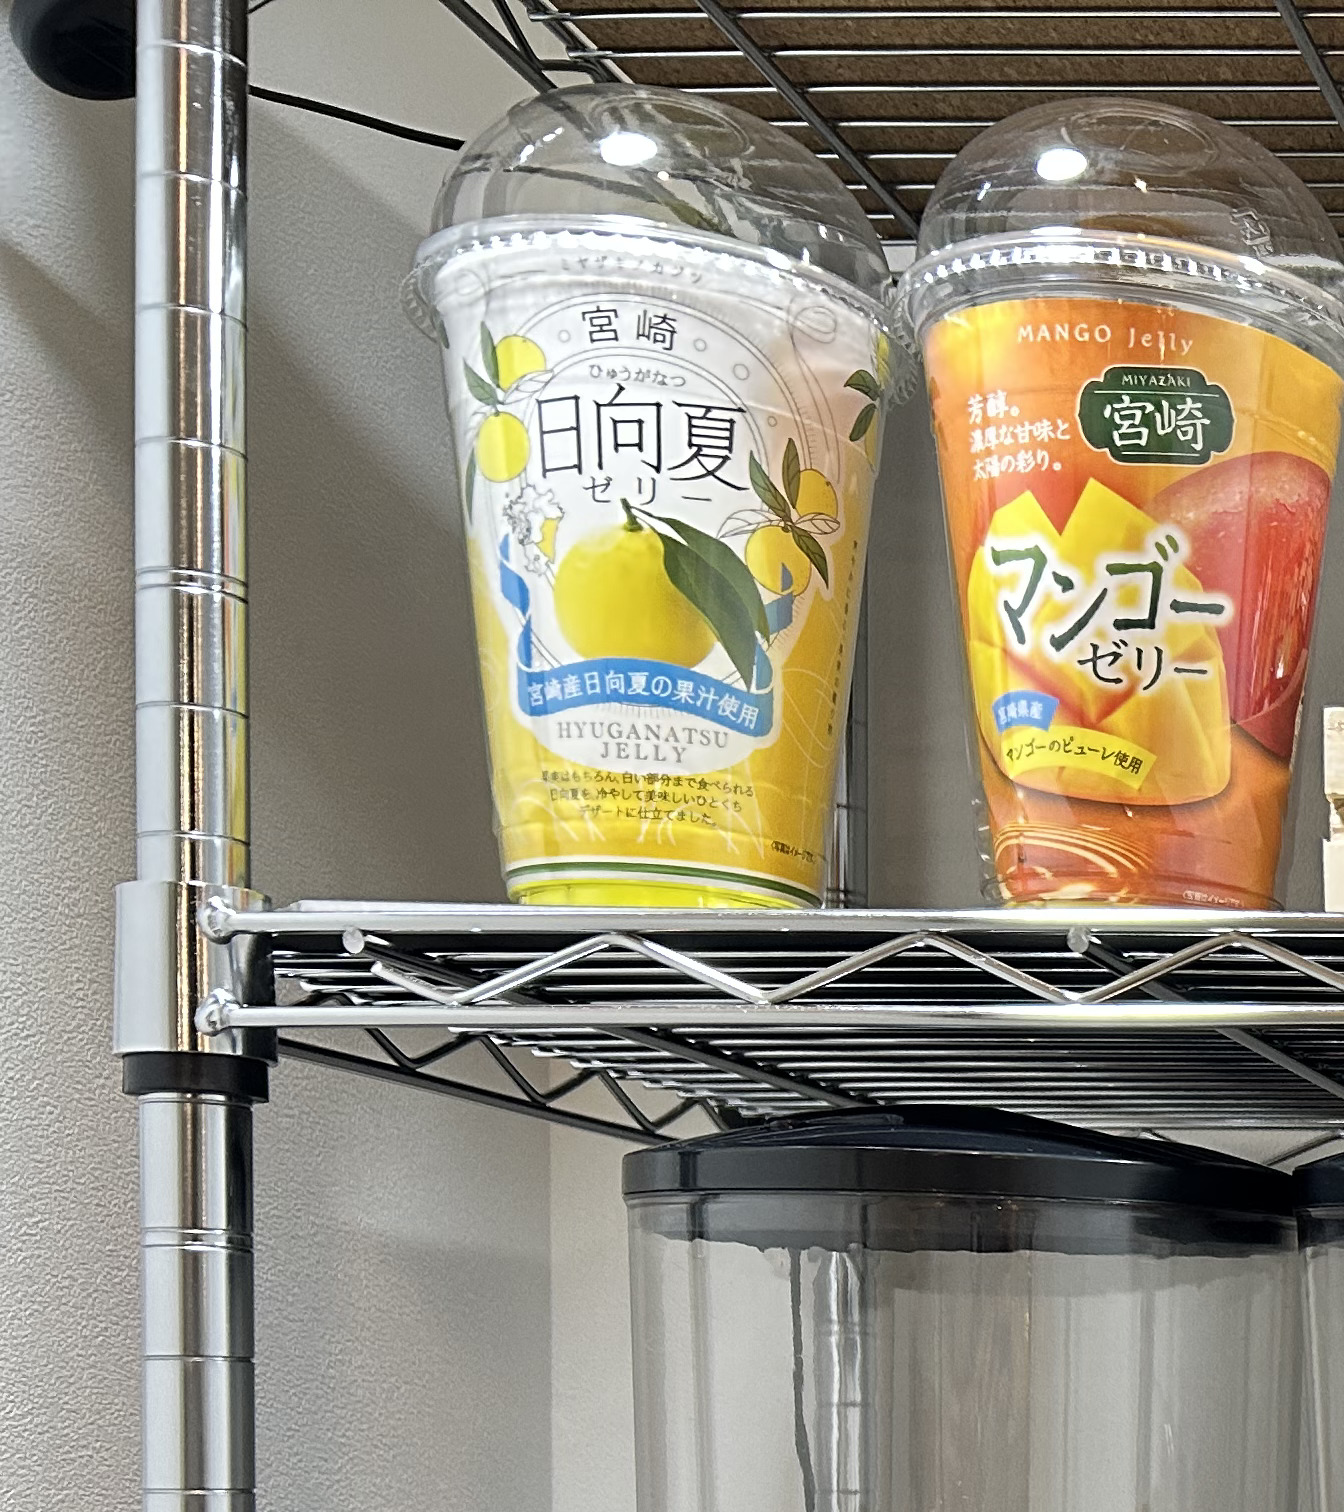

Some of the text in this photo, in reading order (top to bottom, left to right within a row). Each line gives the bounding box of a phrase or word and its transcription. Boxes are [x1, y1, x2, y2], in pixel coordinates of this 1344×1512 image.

[581, 305, 677, 351] 宮崎
[1017, 324, 1193, 354] MANGO Jelly
[589, 364, 686, 387] ひゅうがなつ
[1121, 373, 1191, 389] MIYAZAKI
[967, 390, 1020, 424] 芳醇。
[1104, 395, 1211, 450] 宮崎
[535, 383, 750, 492] 日向夏
[973, 449, 1062, 480] 太陽の彩り。
[583, 474, 712, 506] ゼリー
[991, 534, 1225, 652] マンゴー
[1077, 639, 1208, 690] ゼリー
[527, 670, 760, 731] 宮崎産日向夏の果汁使用
[557, 721, 729, 749] HYUGANATSU
[600, 742, 687, 764] JELLY
[1006, 736, 1143, 774] マンゴーのピューレ使用
